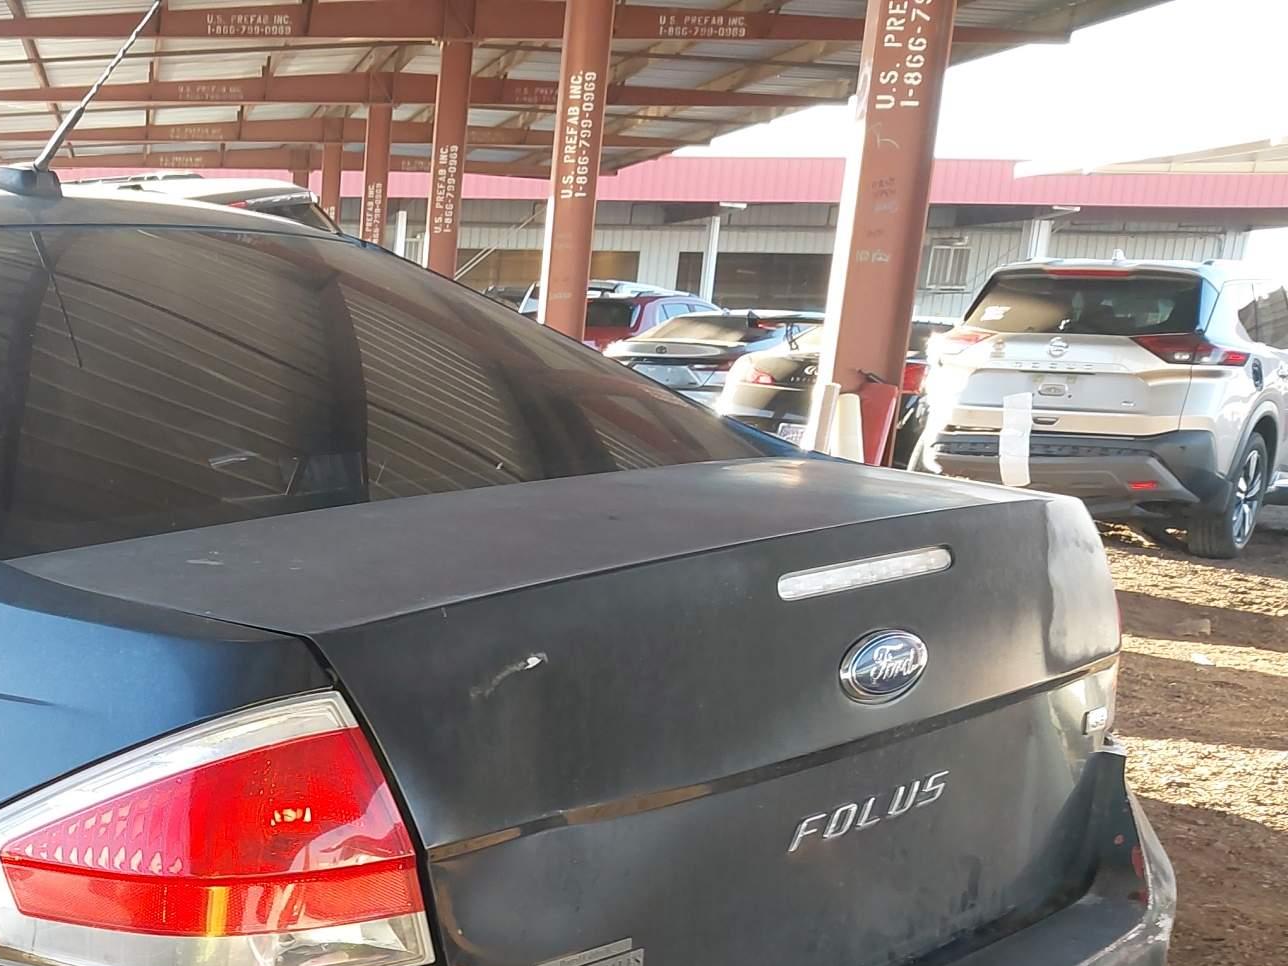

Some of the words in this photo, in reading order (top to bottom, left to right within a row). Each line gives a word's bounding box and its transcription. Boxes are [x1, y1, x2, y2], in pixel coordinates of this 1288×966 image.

[568, 70, 584, 100] INC.
[875, 62, 901, 110] U.S.
[563, 105, 581, 165] PREFAB
[574, 71, 597, 198] 1-866-799-0969
[435, 168, 447, 210] PREFAB
[560, 170, 576, 199] U.S.
[869, 642, 923, 686] Ford
